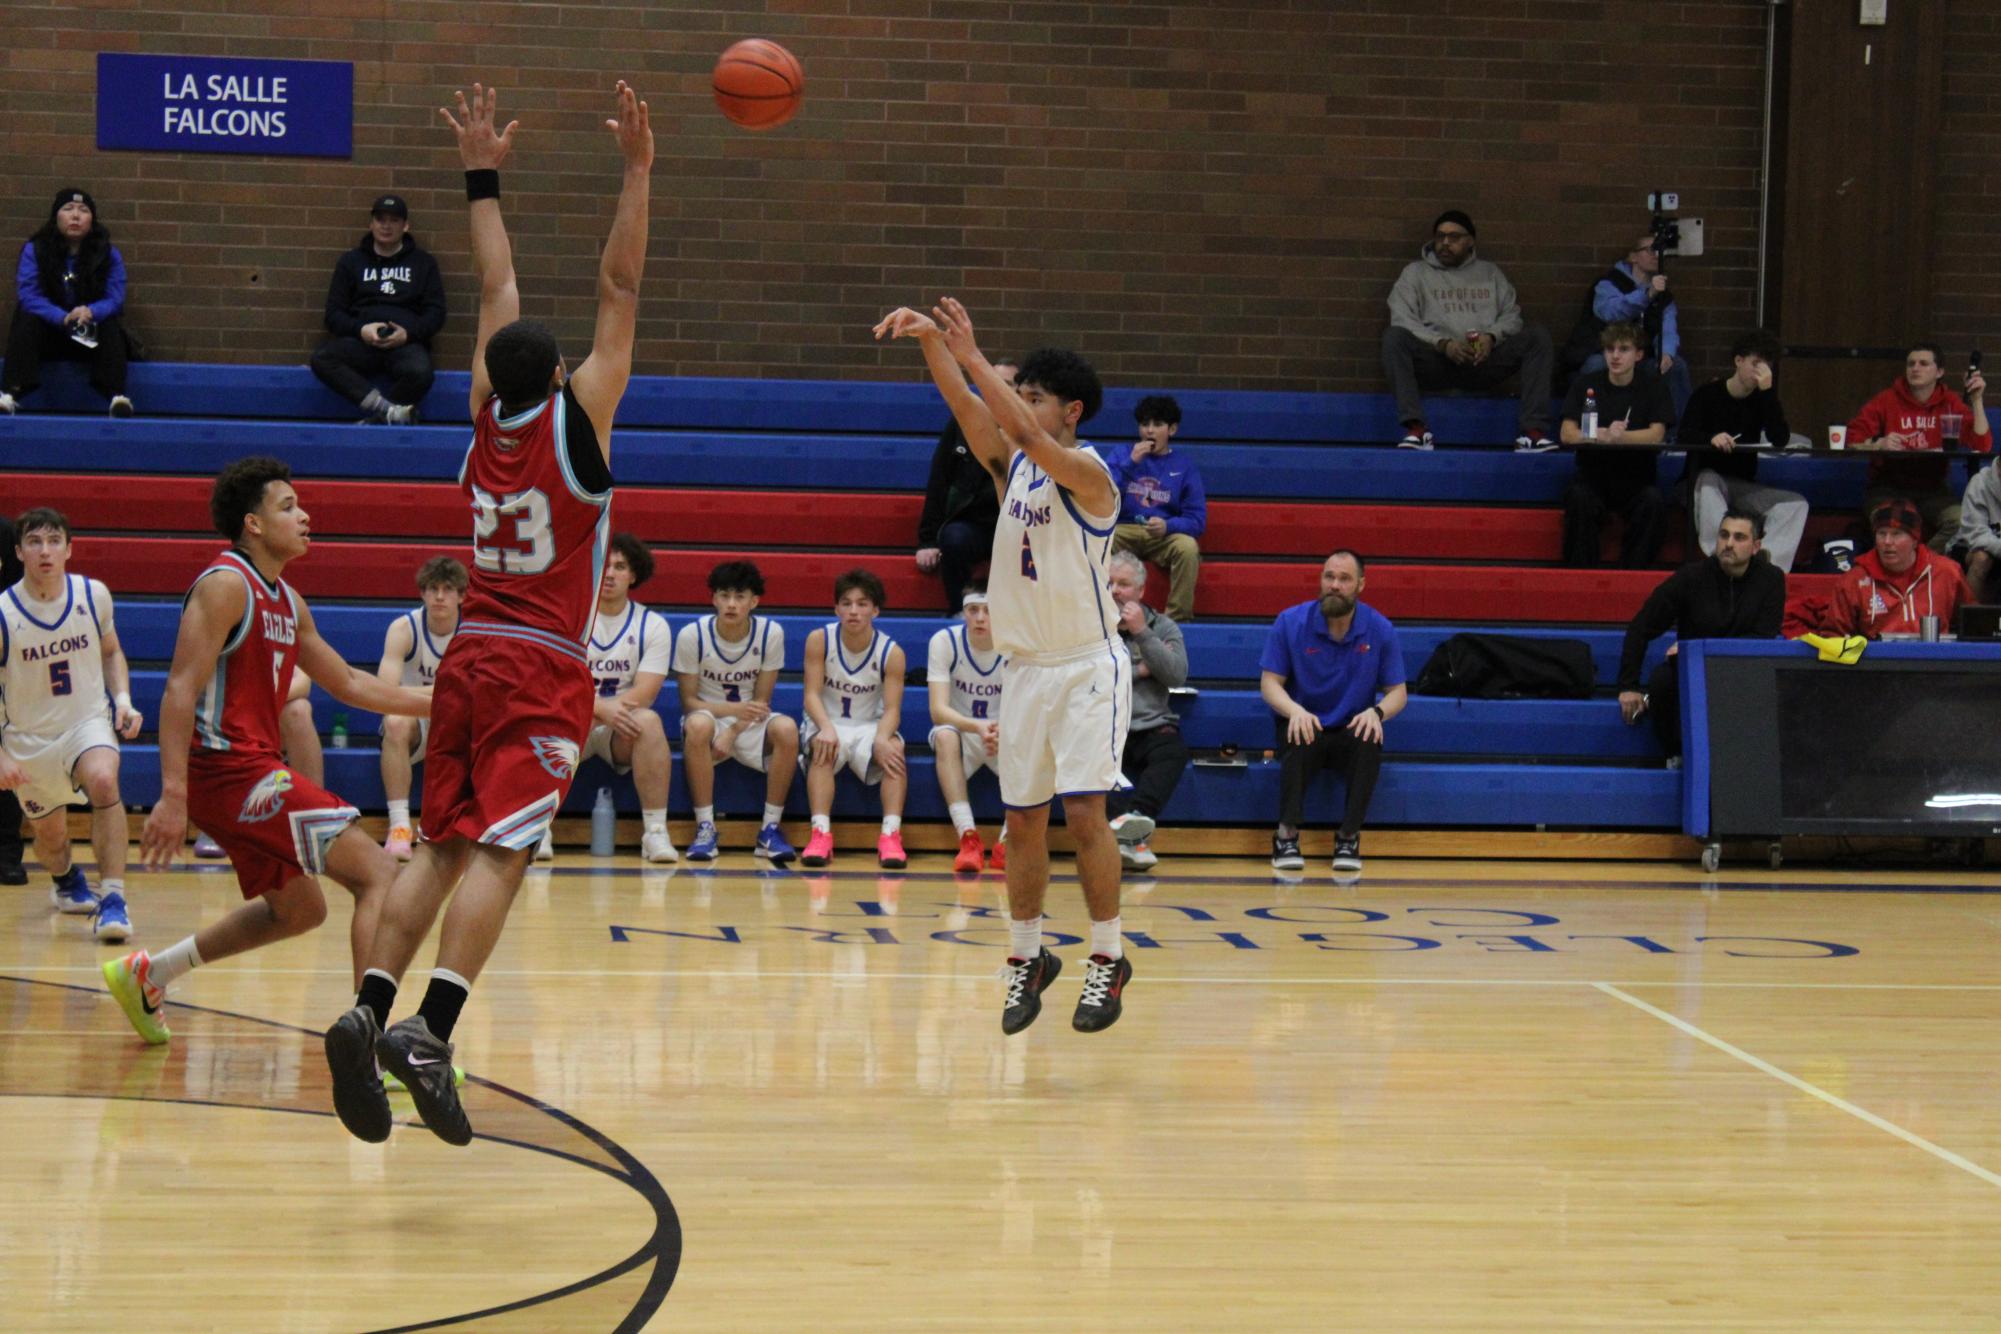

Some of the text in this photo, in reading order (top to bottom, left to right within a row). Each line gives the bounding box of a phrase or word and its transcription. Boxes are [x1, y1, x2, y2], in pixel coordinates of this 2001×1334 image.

[164, 73, 288, 103] LA SALLE
[164, 107, 287, 137] FALCONS
[363, 266, 411, 282] LA SALLE
[1901, 415, 1913, 430] LA
[470, 484, 555, 575] 23
[22, 634, 90, 662] FALCONS
[48, 660, 73, 696] 5
[702, 669, 761, 683] FALCONS
[840, 696, 853, 719] 1
[608, 924, 1861, 959] CLEGHORN
